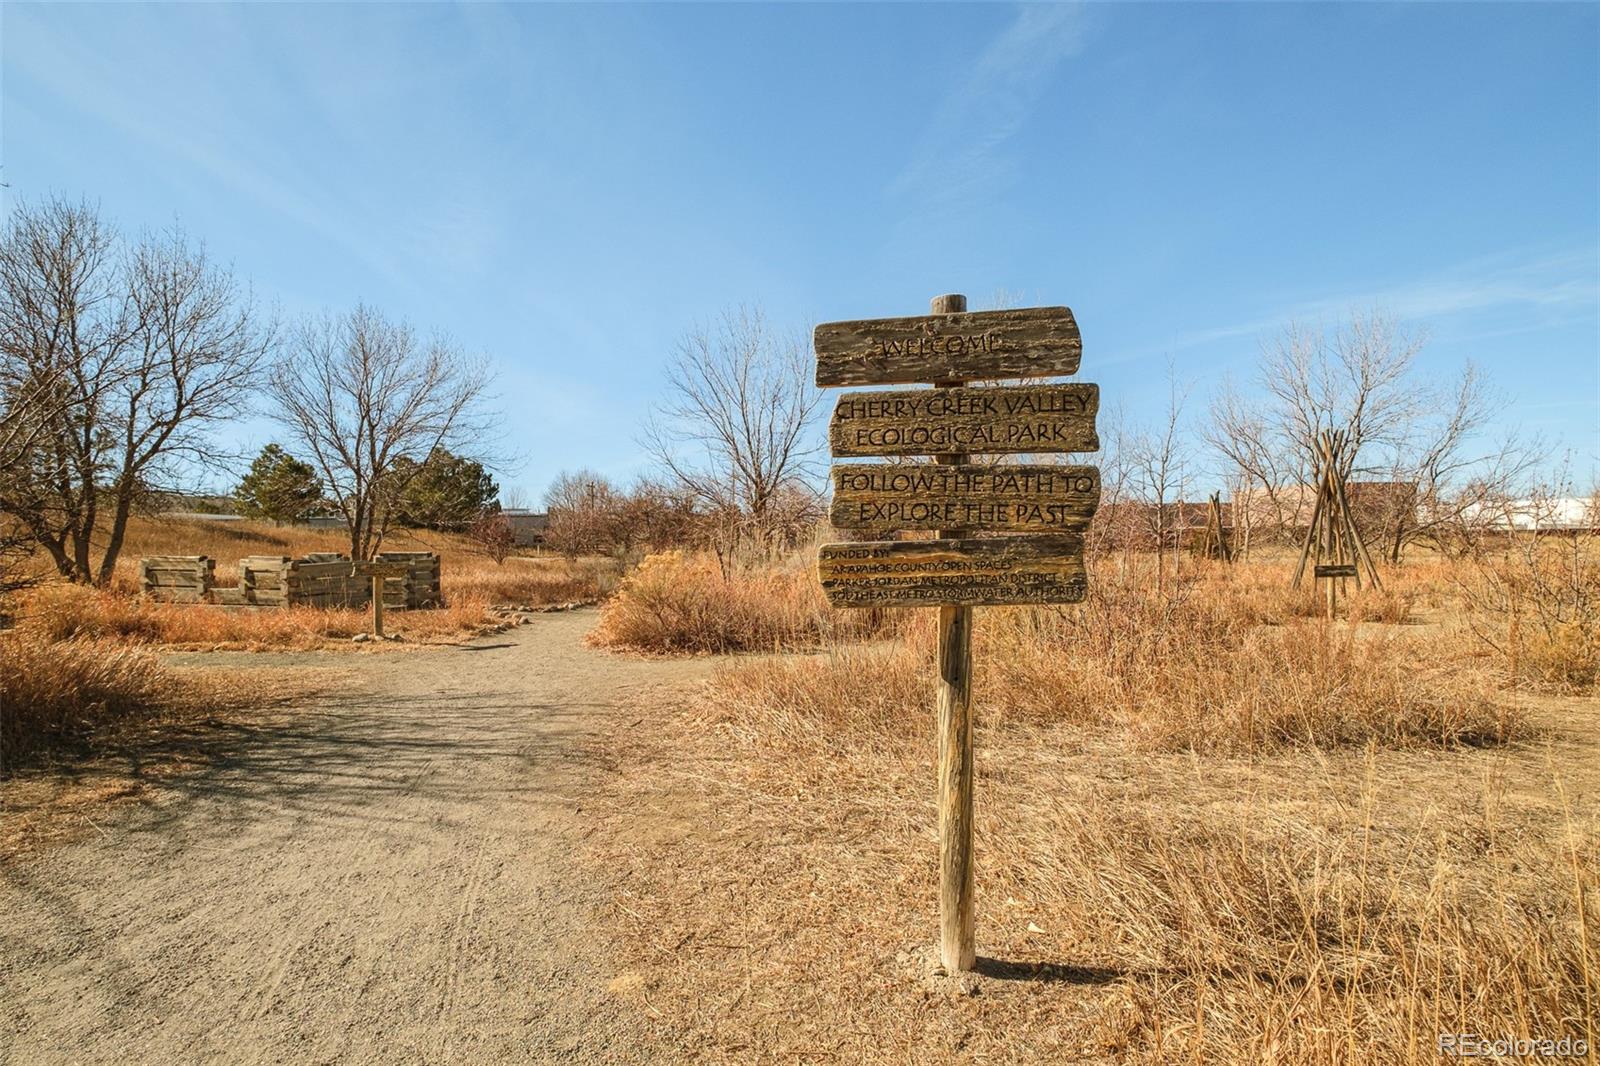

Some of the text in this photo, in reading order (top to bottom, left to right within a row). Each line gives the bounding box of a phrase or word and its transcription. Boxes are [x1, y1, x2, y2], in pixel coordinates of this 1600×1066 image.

[881, 333, 1001, 358] WELCOME
[836, 393, 1091, 420] CHERRY CREEK VALLEY
[857, 424, 1067, 447] ECOLOGICAL PARK
[841, 474, 1093, 494] FOLLOW THE PATH TO
[860, 503, 1073, 525] EXPLORE THE PAST
[823, 549, 890, 559] FUNDED BY:
[832, 560, 1012, 574] ARAPAHOE COUNTY OPEN SPACES
[832, 577, 870, 588] PARKER
[922, 574, 1007, 586] METROPOLITAN
[1011, 573, 1058, 583] DISTRICT
[832, 585, 1085, 600] SOUTHEAST METRO STORMWATER AUTHORITY
